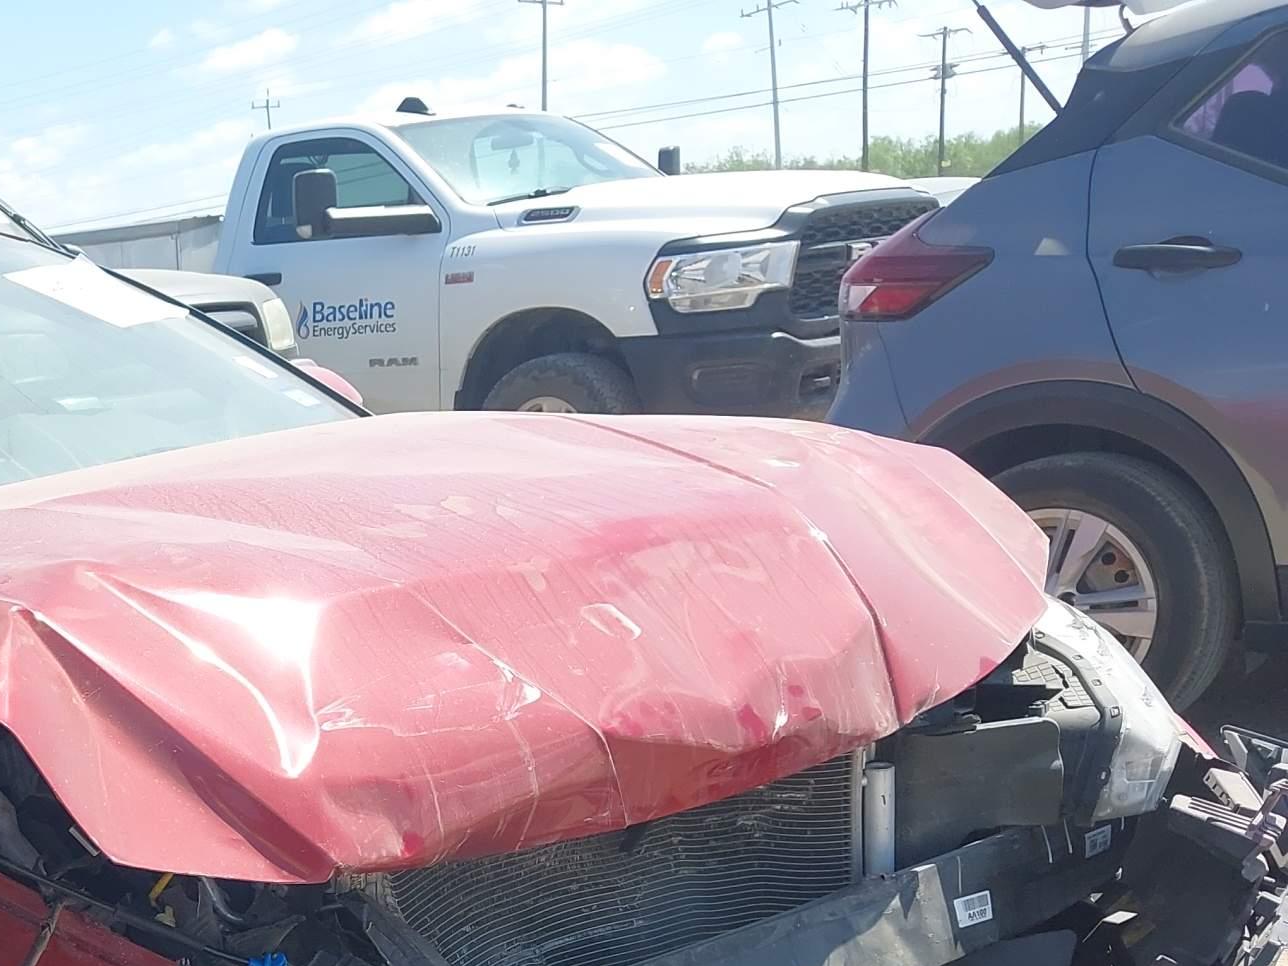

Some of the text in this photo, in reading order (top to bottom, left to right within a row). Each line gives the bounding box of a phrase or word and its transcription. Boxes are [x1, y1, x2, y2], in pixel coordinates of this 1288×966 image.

[449, 245, 477, 257] T1131
[312, 298, 396, 323] Baseline
[368, 357, 419, 368] RAM
